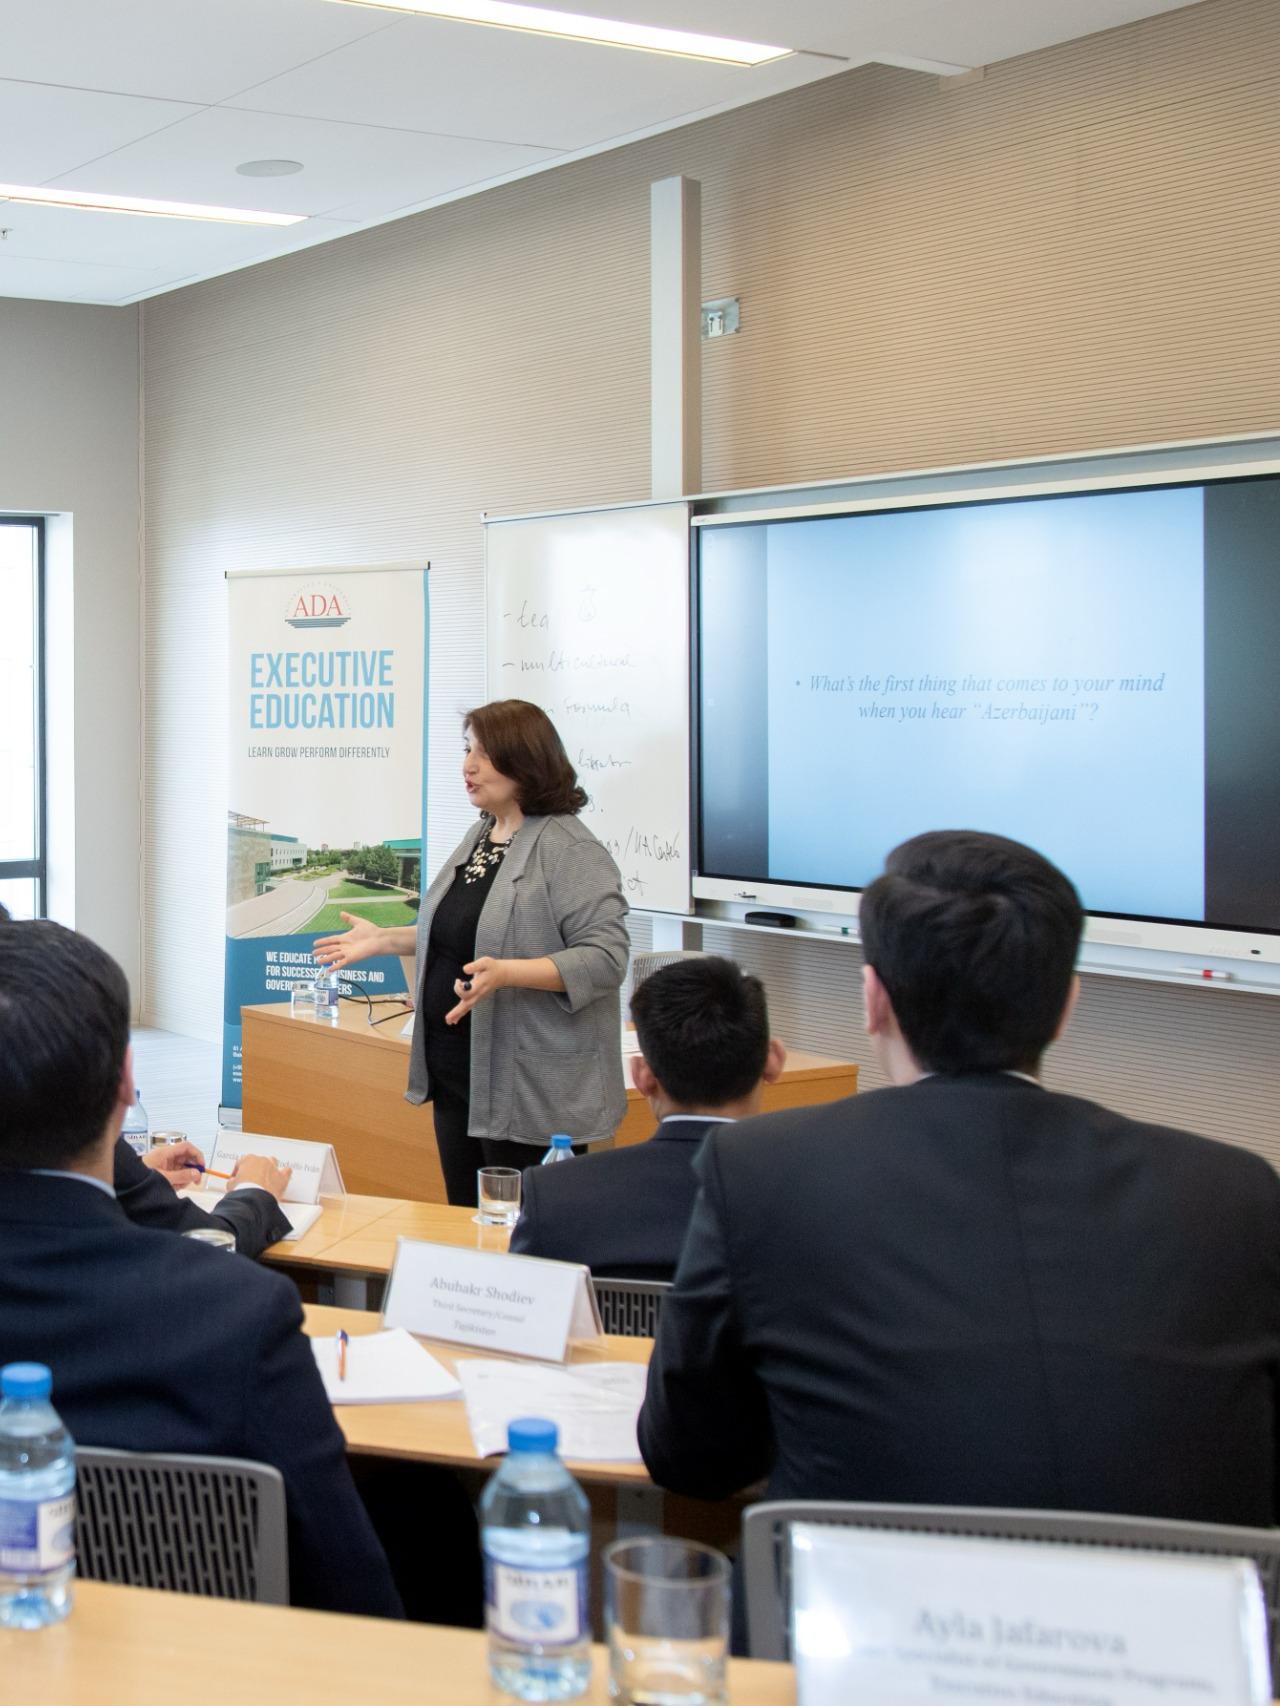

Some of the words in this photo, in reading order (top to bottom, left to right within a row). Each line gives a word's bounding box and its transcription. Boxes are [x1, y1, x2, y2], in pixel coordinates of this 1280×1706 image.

[293, 594, 344, 617] ADA
[517, 600, 549, 630] tea
[250, 650, 394, 688] EXECUTIVE
[858, 675, 881, 692] the
[882, 675, 914, 696] first
[918, 675, 957, 696] thing
[961, 674, 992, 692] that
[996, 677, 1047, 693] comes
[1052, 676, 1069, 693] to
[1073, 677, 1115, 697] your
[1119, 672, 1166, 692] mind
[250, 692, 395, 729] EDUCATION
[858, 702, 895, 719] when
[898, 705, 928, 724] you
[931, 702, 966, 720] hear
[248, 746, 273, 758] LEARN
[275, 747, 298, 758] GROW
[300, 747, 337, 758] PERFORM
[339, 747, 390, 758] DIFFERENTLY
[266, 951, 278, 962] WE
[280, 951, 313, 964] EDUCATE
[266, 965, 280, 976] FOR
[368, 971, 384, 983] AND
[486, 1286, 536, 1305] Shodiev
[914, 1607, 984, 1644] Ayla
[989, 1613, 1128, 1657] Jafarova
